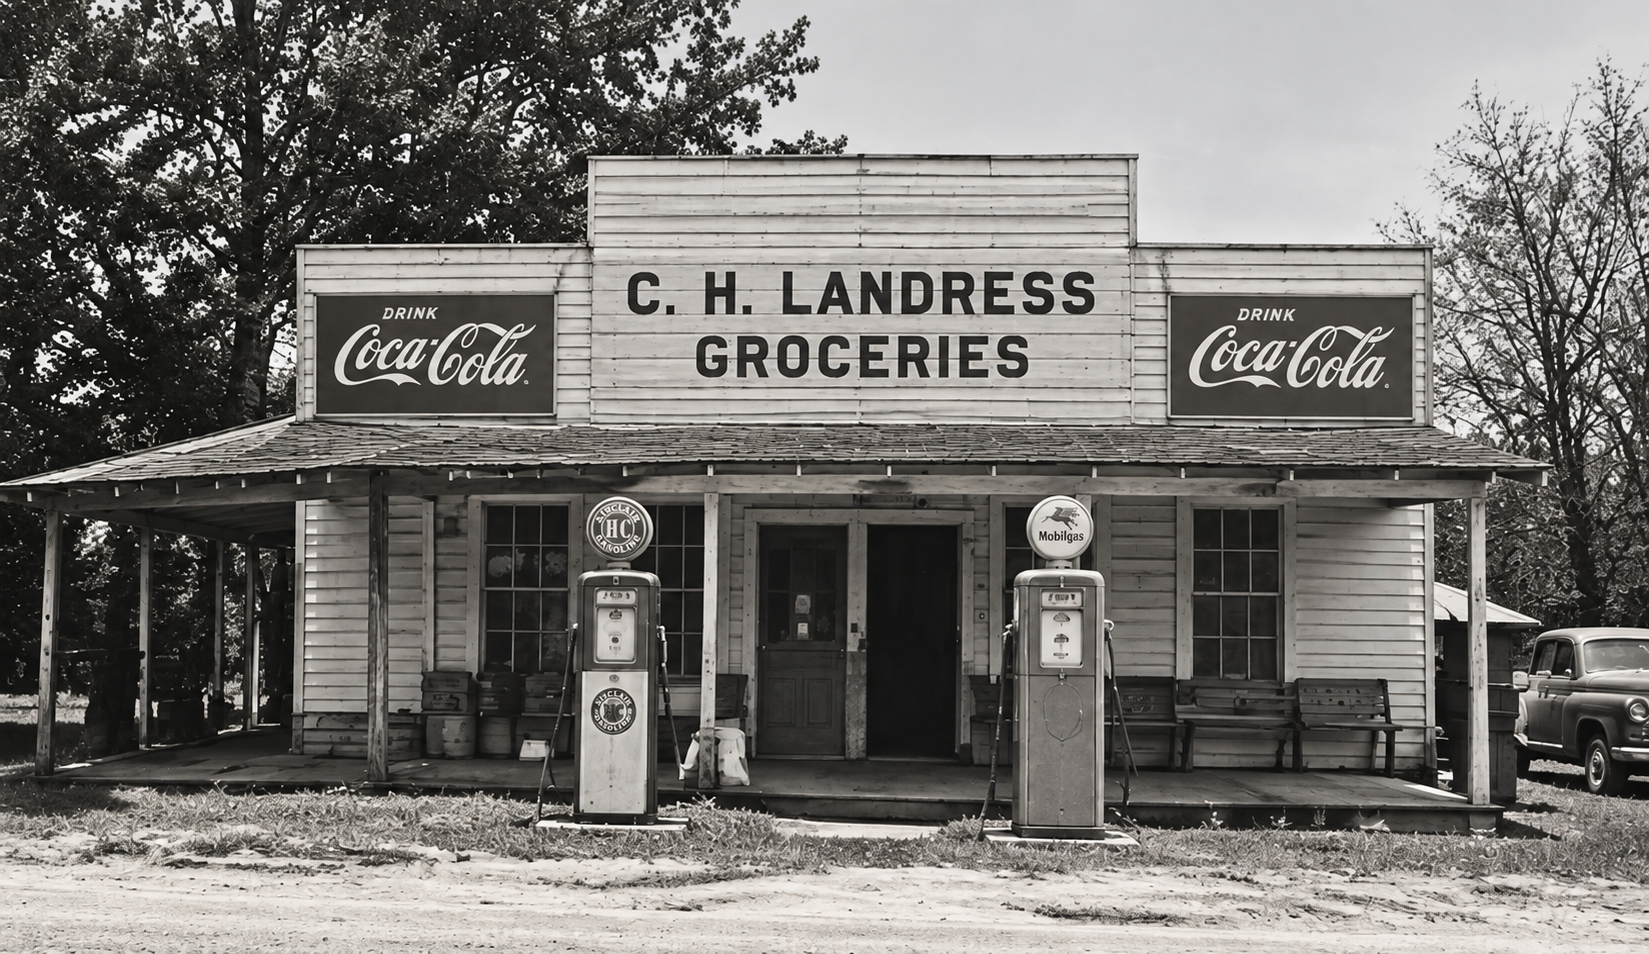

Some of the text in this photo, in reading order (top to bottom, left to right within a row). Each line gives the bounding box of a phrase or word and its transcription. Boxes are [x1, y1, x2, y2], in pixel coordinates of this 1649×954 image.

[627, 271, 1096, 316] C. H. LANDRESS
[382, 306, 439, 320] DRINK
[1237, 307, 1296, 322] DRINK
[334, 323, 537, 386] Coca-Cola
[696, 335, 1029, 379] GROCERIES
[1188, 325, 1395, 389] Coca-Cola
[606, 519, 631, 539] HC
[1038, 530, 1084, 544] Mobilgas
